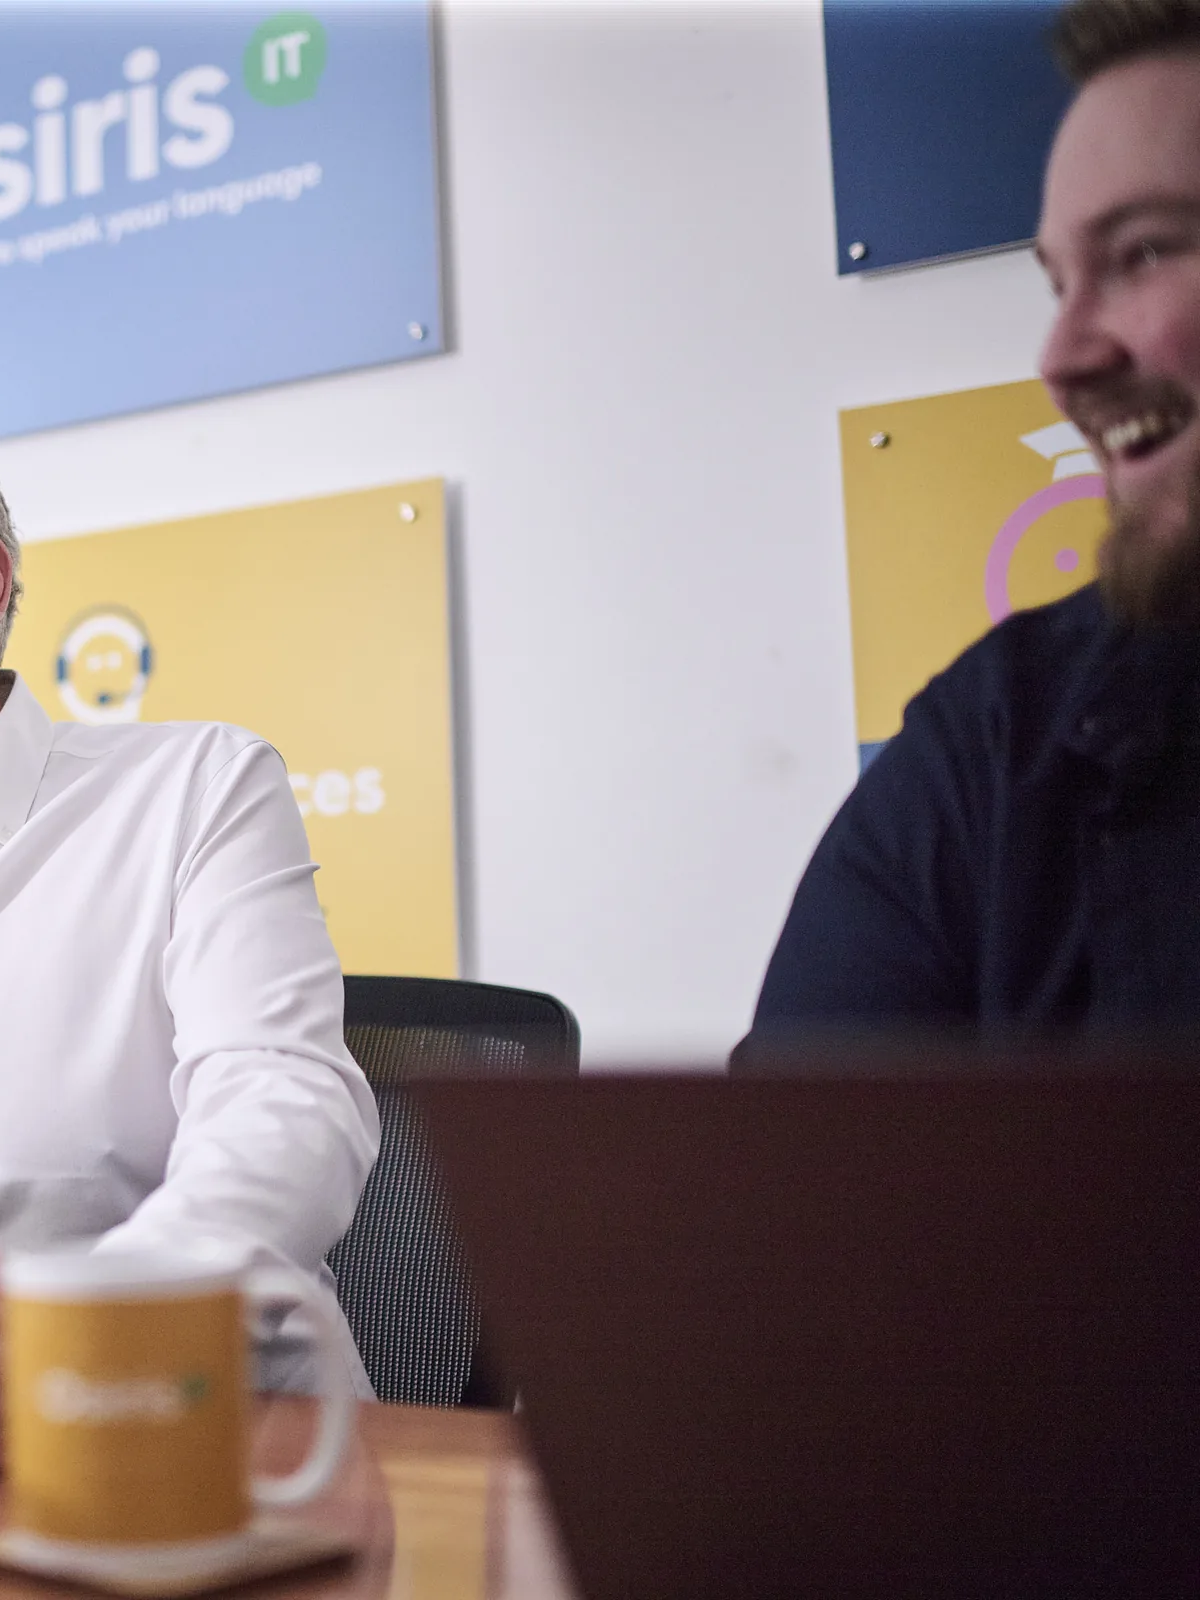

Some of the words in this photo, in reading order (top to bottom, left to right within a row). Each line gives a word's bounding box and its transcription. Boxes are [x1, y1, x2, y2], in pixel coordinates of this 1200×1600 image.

[262, 31, 311, 84] IT
[17, 213, 102, 266] speak
[105, 199, 170, 246] your
[172, 161, 323, 218] language
